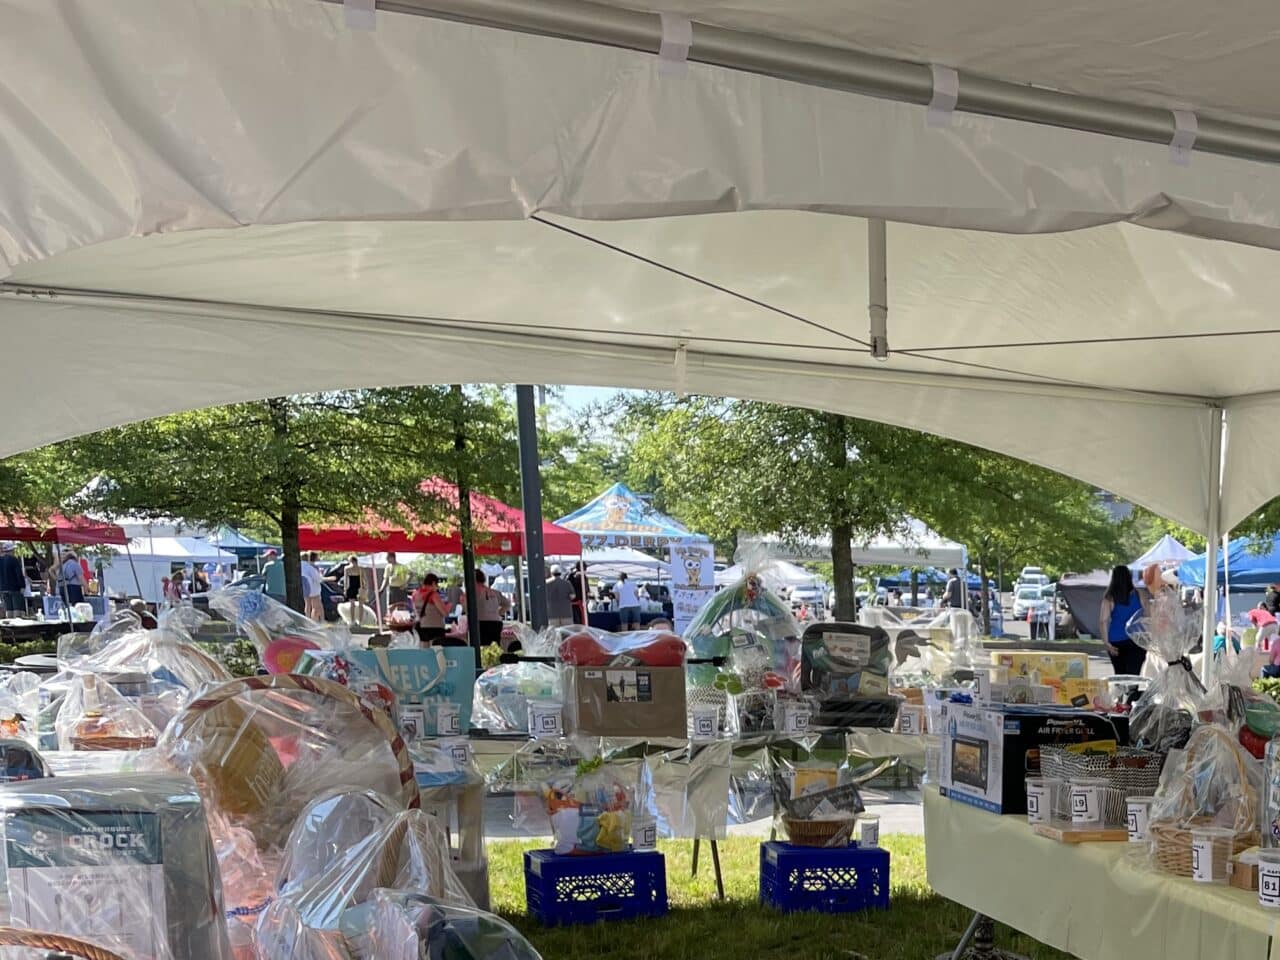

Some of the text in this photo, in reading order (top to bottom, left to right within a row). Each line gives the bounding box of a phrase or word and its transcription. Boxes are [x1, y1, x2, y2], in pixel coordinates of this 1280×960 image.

[1038, 727, 1051, 735] AIR
[1074, 797, 1085, 808] 19
[68, 832, 146, 849] CROCK
[1263, 880, 1279, 892] 81
